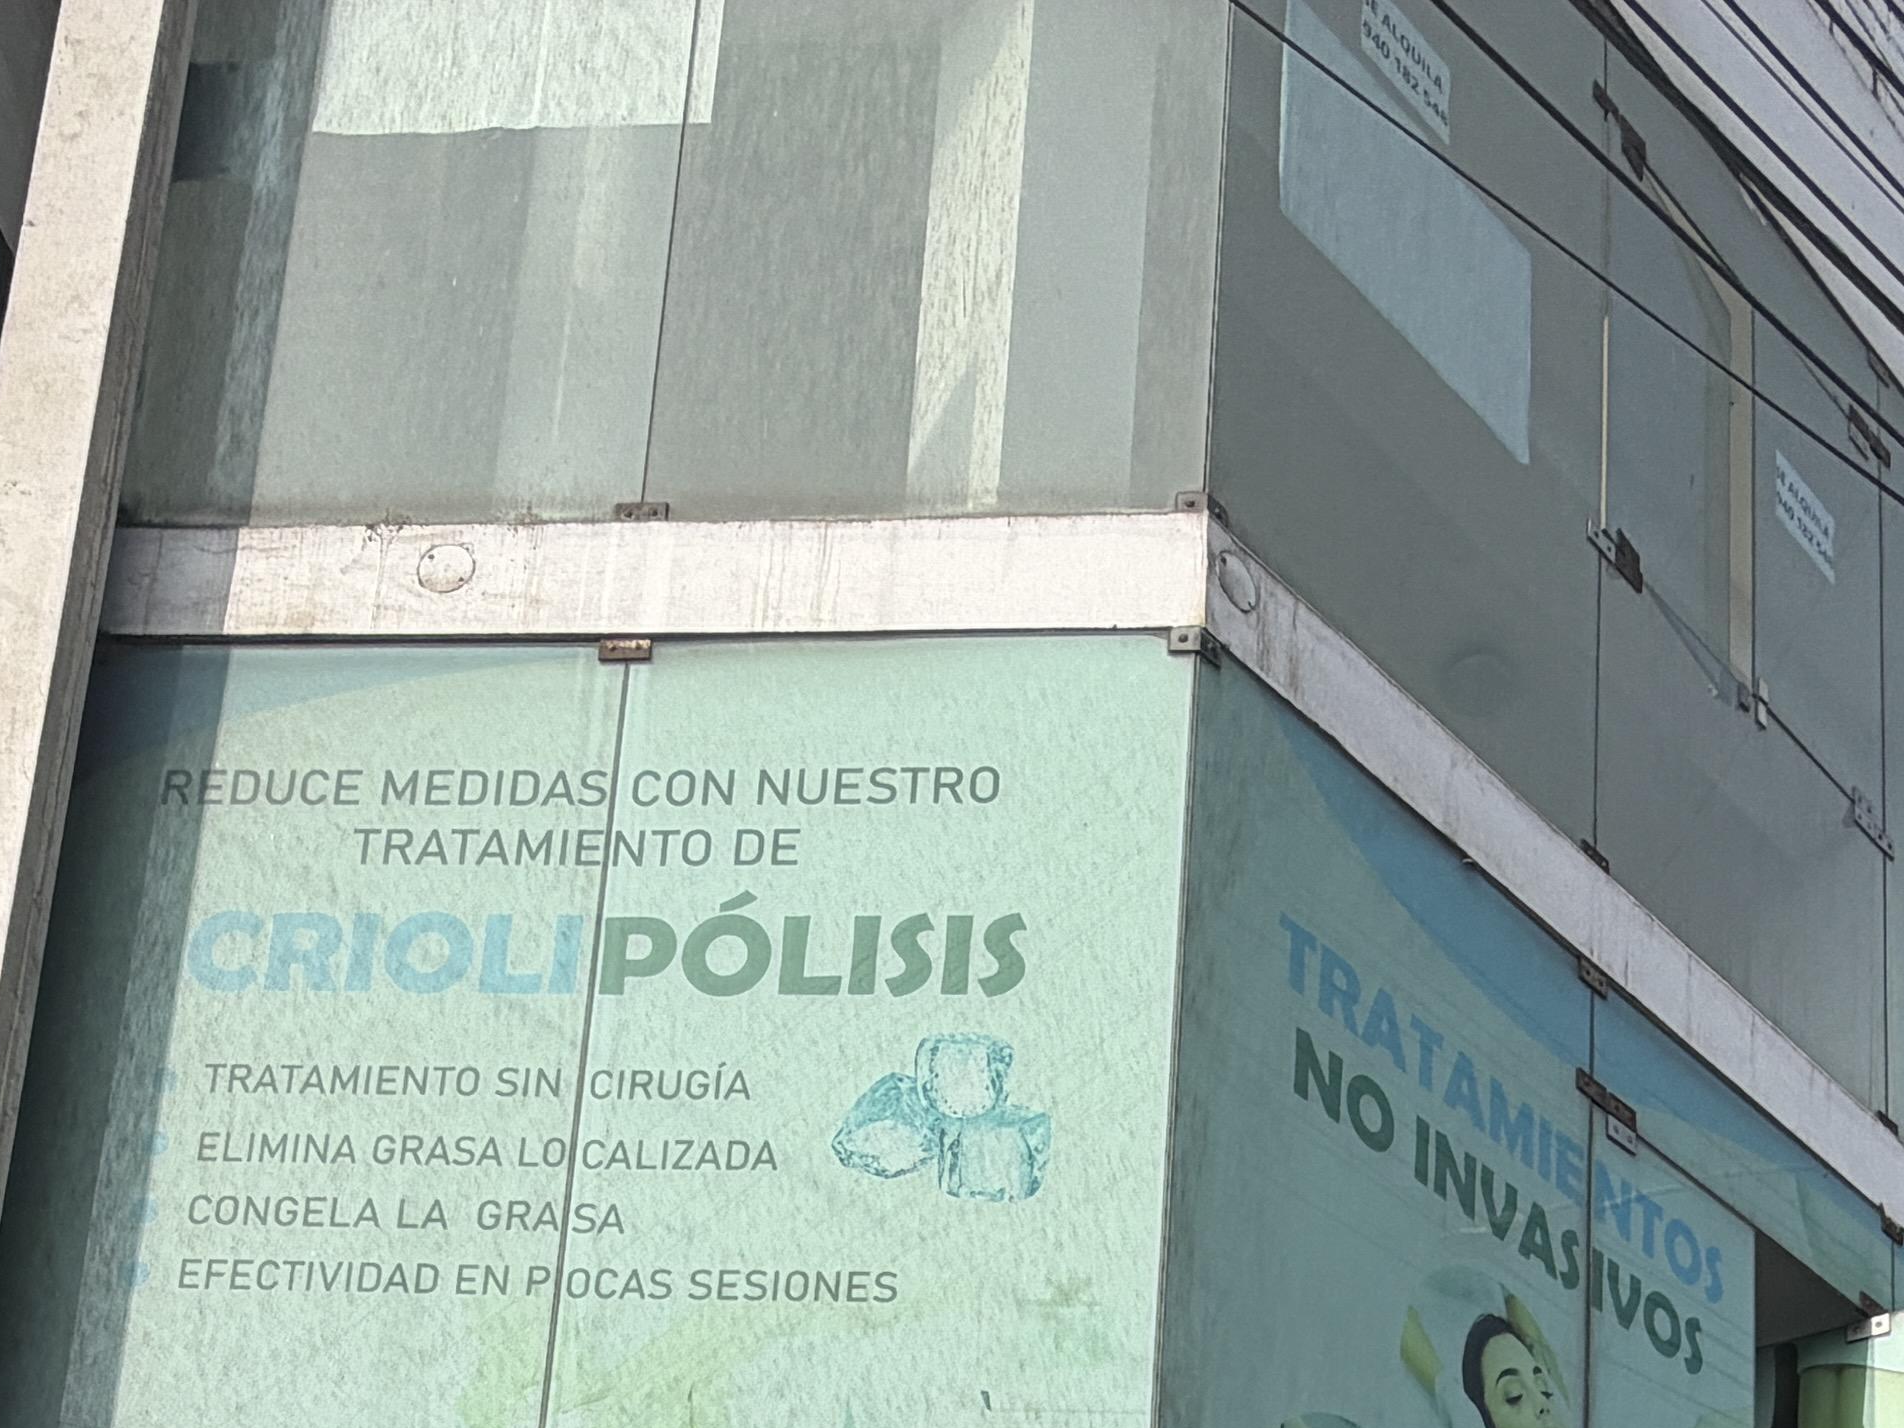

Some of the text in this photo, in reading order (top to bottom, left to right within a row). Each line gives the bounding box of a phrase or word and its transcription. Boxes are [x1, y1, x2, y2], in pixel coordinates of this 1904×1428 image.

[160, 766, 1001, 807] REDUCE MEDIDAS CON NUESTRO
[354, 827, 802, 868] TRATAMIENTO DE
[205, 1061, 753, 1103] TRATAMIENTO SIN CIRUGÍA
[1277, 912, 1724, 1304] TRATAMIENTOS
[196, 1131, 779, 1173] ELIMINA GRASA LOCALIZADA
[186, 1193, 625, 1236] CONGELA LA GRASA
[1291, 1030, 1707, 1377] NO INVASIVOS
[176, 1257, 900, 1305] EFECTIVIDAD EN POCAS SESIONES
